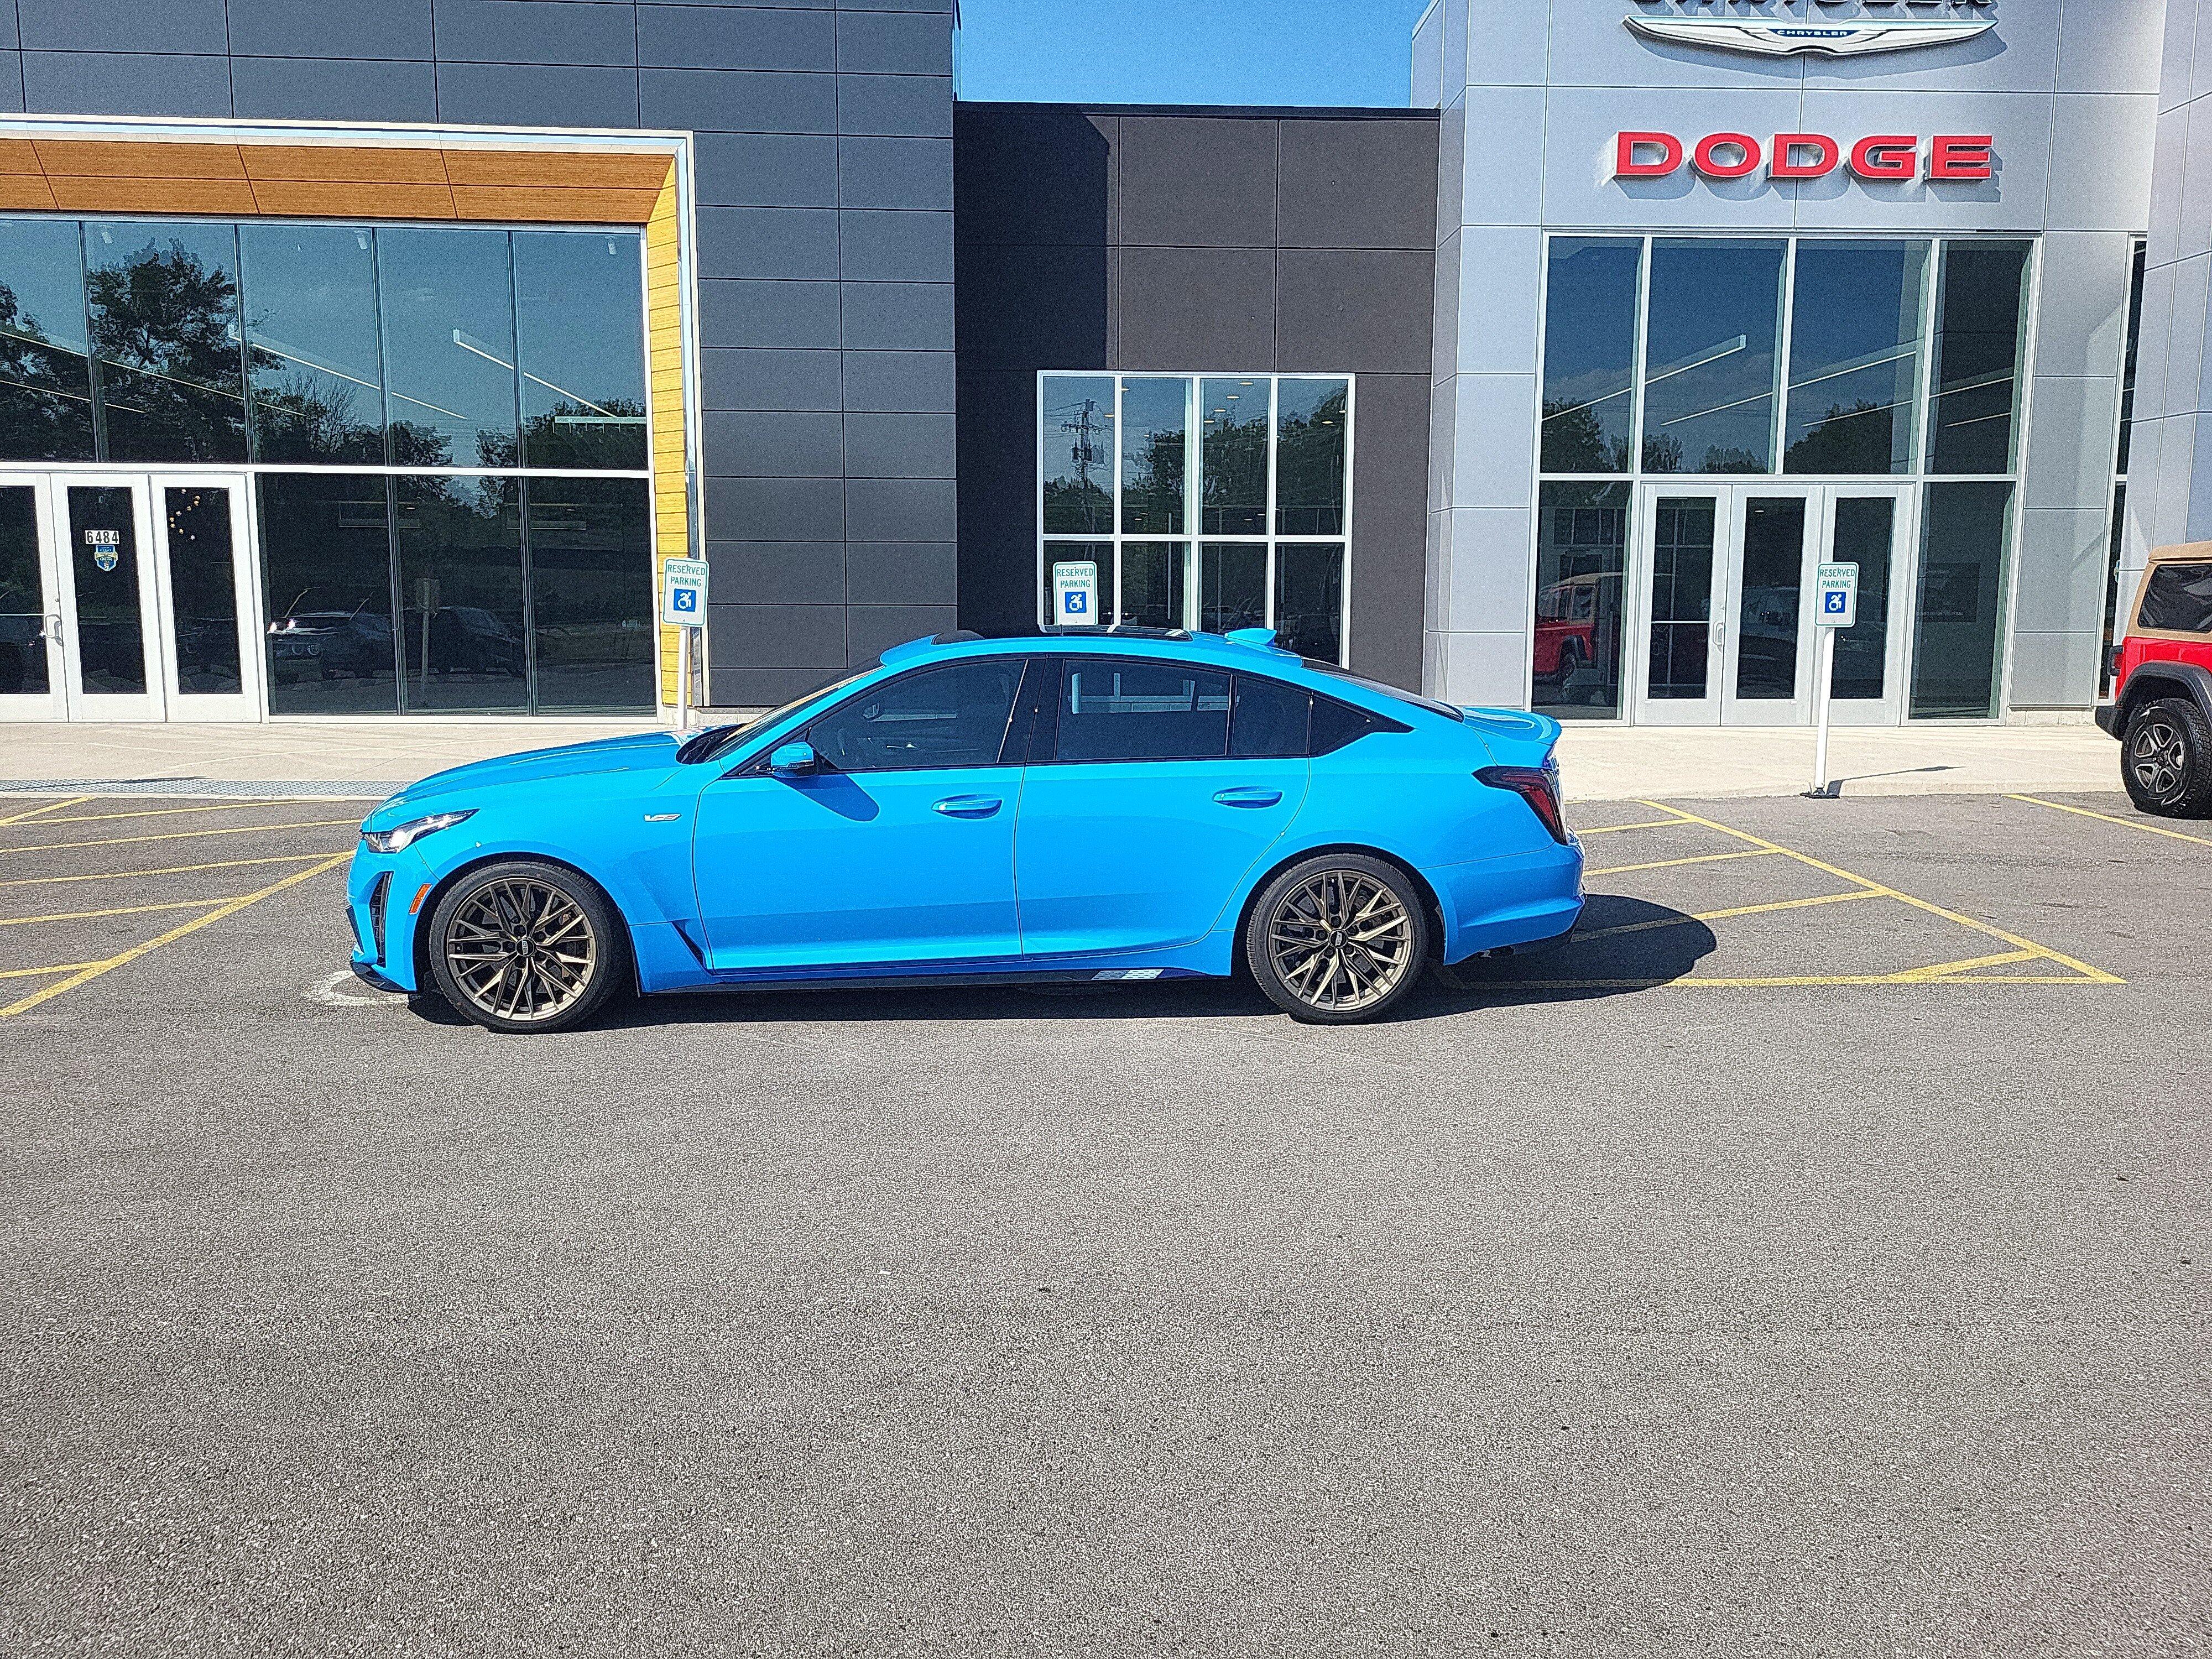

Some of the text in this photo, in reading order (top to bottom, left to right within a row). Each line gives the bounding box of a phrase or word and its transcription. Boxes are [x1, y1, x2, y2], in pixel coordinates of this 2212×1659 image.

[1615, 131, 1992, 179] DODGE
[87, 531, 118, 543] 6484
[667, 564, 706, 576] RESERVED
[1057, 568, 1093, 577] RESERVED
[1819, 568, 1855, 577] RESERVED
[670, 576, 702, 587] PARKING
[1060, 580, 1091, 588] PARKING
